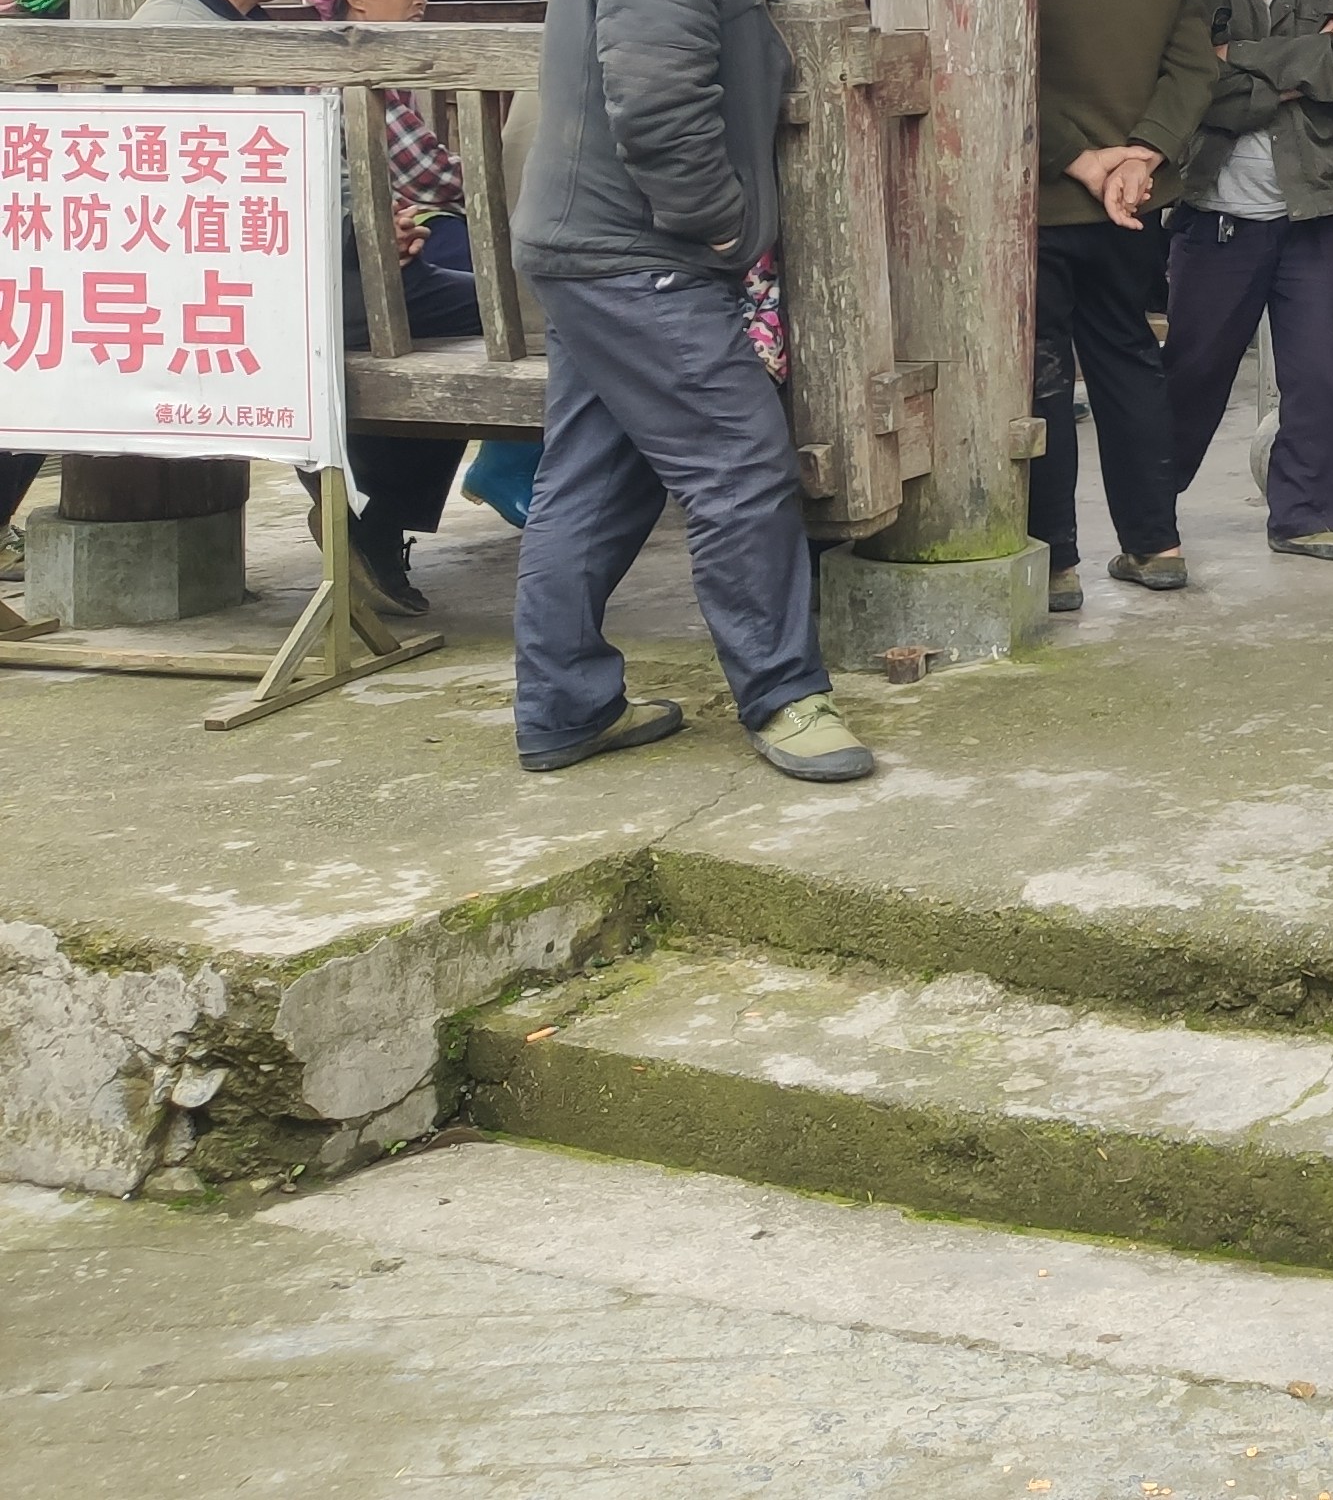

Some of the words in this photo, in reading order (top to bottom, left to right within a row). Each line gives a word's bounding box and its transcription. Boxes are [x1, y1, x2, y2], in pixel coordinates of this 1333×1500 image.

[2, 123, 291, 185] 路交通安全
[3, 192, 291, 256] 林防火值勤
[0, 266, 261, 376] 劝导点
[154, 402, 296, 429] 德化乡人民政府
